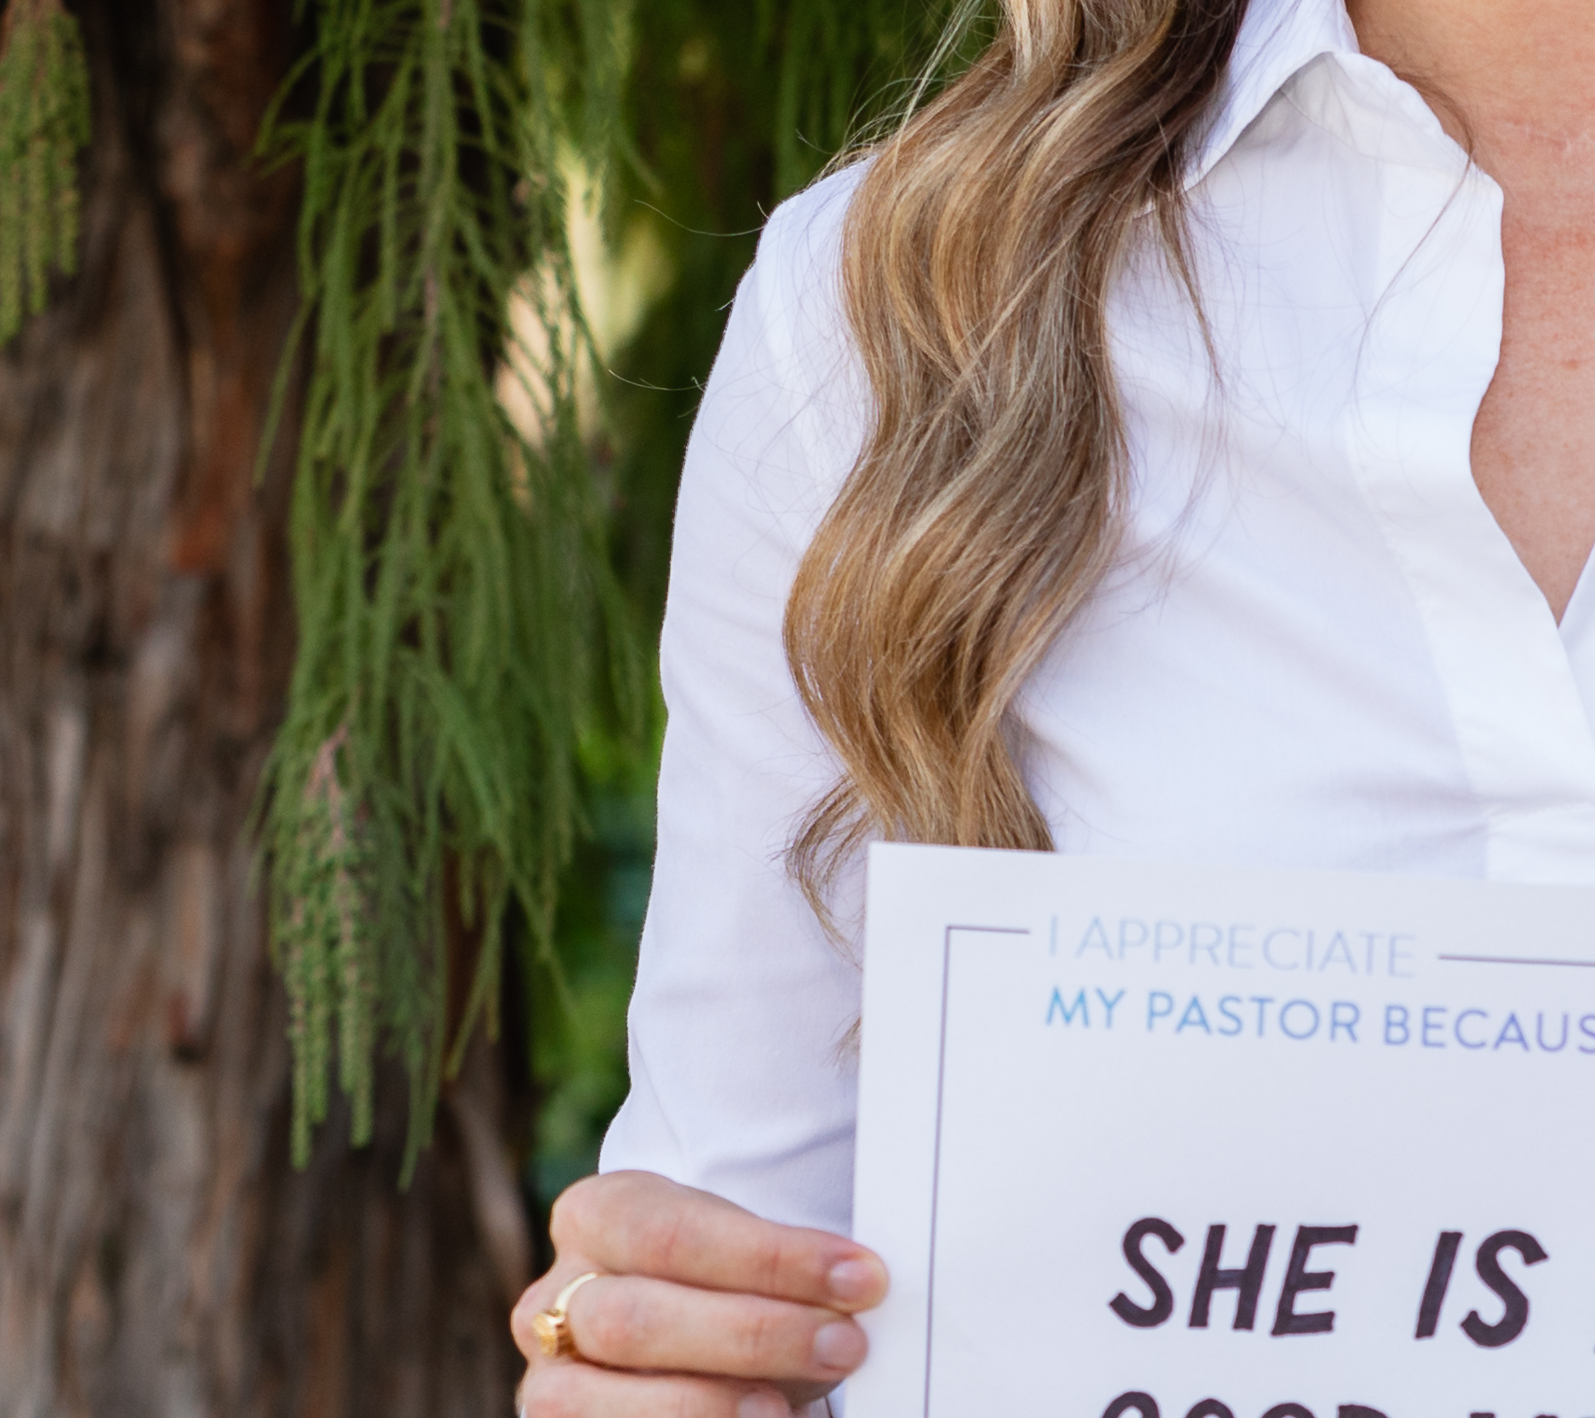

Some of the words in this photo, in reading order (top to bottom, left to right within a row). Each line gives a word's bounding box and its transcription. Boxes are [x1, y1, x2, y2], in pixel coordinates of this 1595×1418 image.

[1047, 914, 1060, 958] I
[1074, 915, 1417, 979] APPRECIATE
[1045, 986, 1126, 1029] MY
[1145, 989, 1362, 1044] PASTOR
[1107, 1216, 1360, 1338] SHE
[1413, 1228, 1550, 1349] IS
